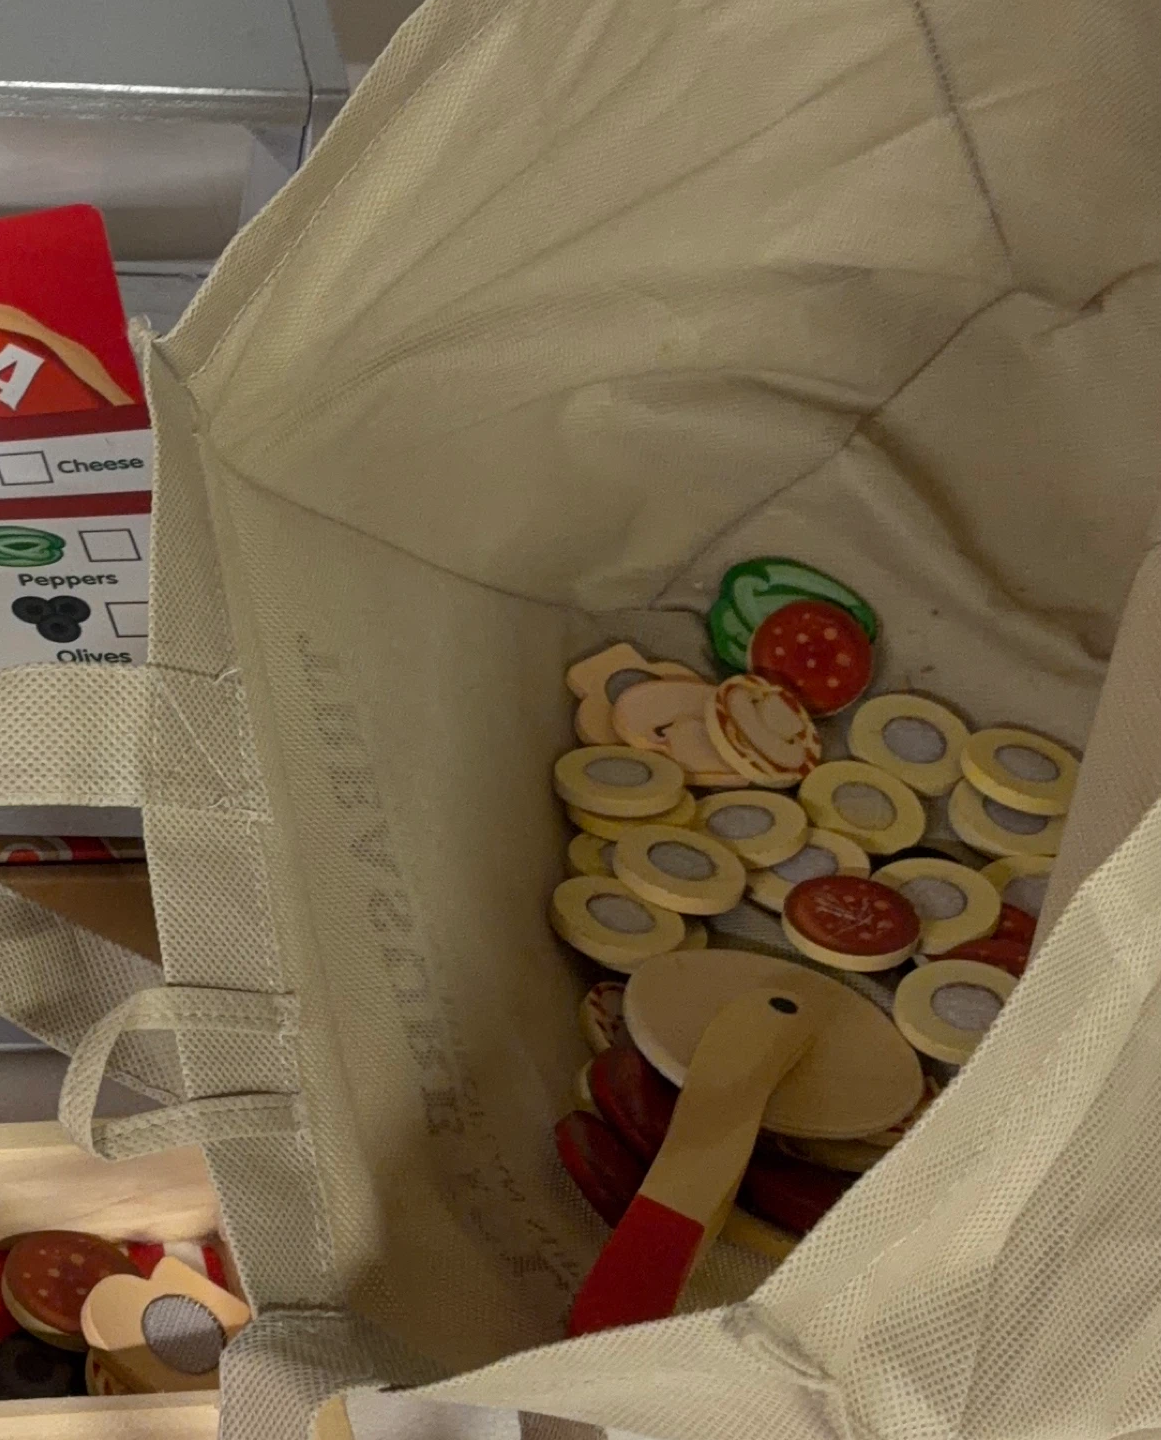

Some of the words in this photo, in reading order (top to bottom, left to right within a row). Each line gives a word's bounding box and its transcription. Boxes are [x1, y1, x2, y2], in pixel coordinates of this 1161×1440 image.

[56, 454, 145, 475] Cheese
[18, 571, 119, 589] Peppers
[56, 649, 133, 663] Olives
